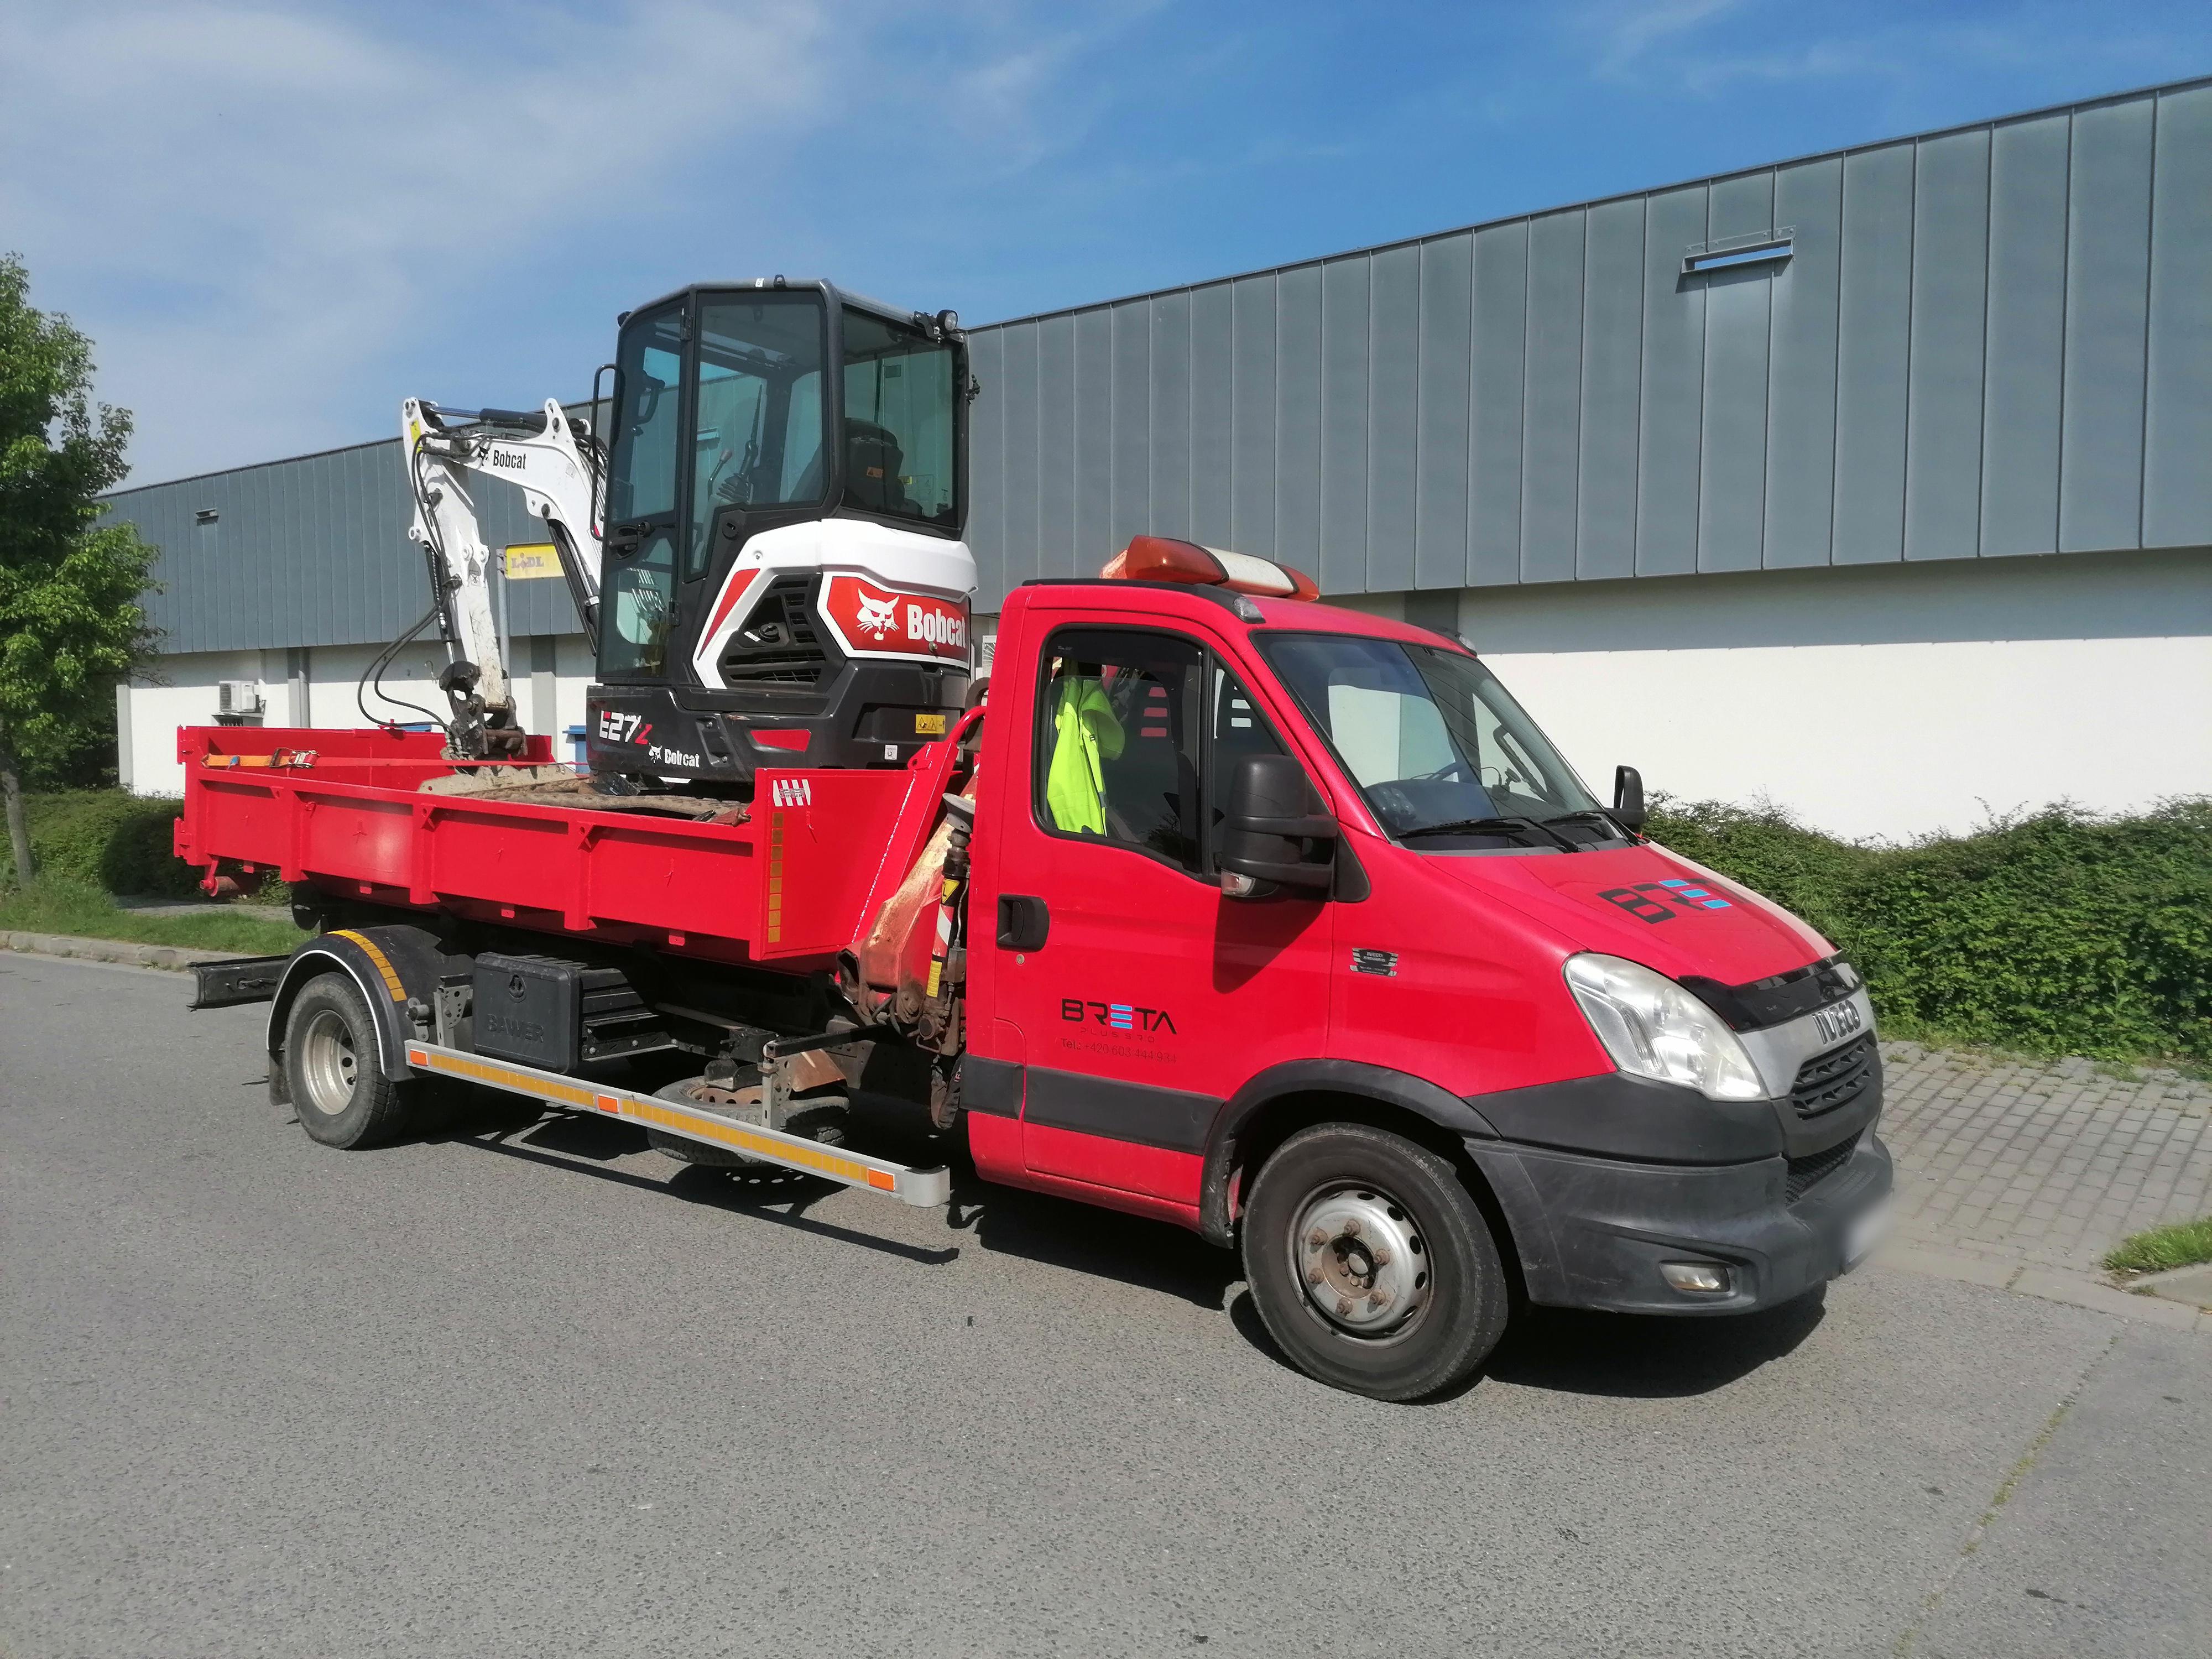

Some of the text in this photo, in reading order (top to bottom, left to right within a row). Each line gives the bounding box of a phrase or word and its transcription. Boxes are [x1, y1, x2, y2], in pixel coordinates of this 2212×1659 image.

[493, 450, 526, 469] Bobcat
[907, 603, 966, 649] Bobcat
[487, 1013, 544, 1043] BAWER
[1062, 998, 1177, 1035] BRETA
[1812, 999, 1861, 1045] IVECO
[1080, 1027, 1119, 1038] PLUS
[1085, 1042, 1109, 1054] +420
[1112, 1045, 1131, 1057] 603
